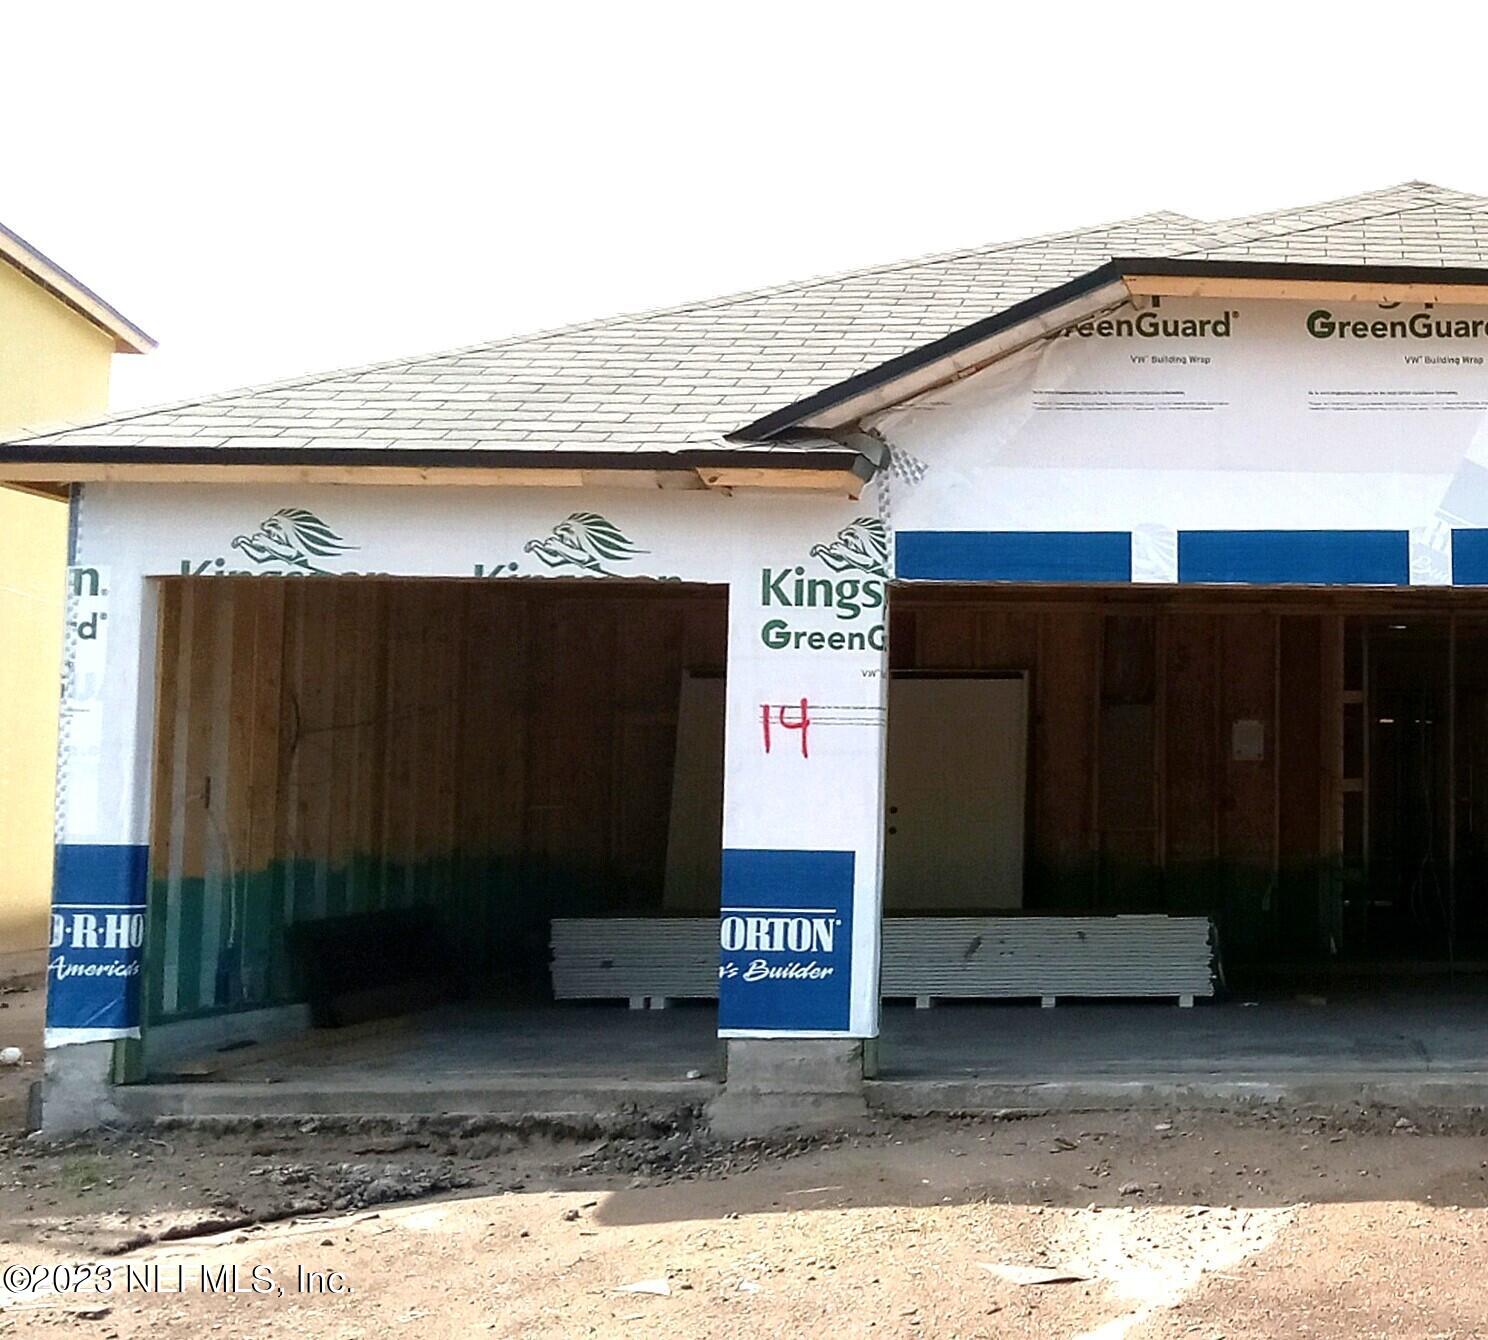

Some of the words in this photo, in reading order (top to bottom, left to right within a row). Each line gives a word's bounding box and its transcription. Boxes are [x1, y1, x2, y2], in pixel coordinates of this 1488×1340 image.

[1424, 355, 1460, 366] Building
[1462, 355, 1484, 365] Wrap
[763, 698, 810, 759] 14
[743, 959, 834, 981] Builder
